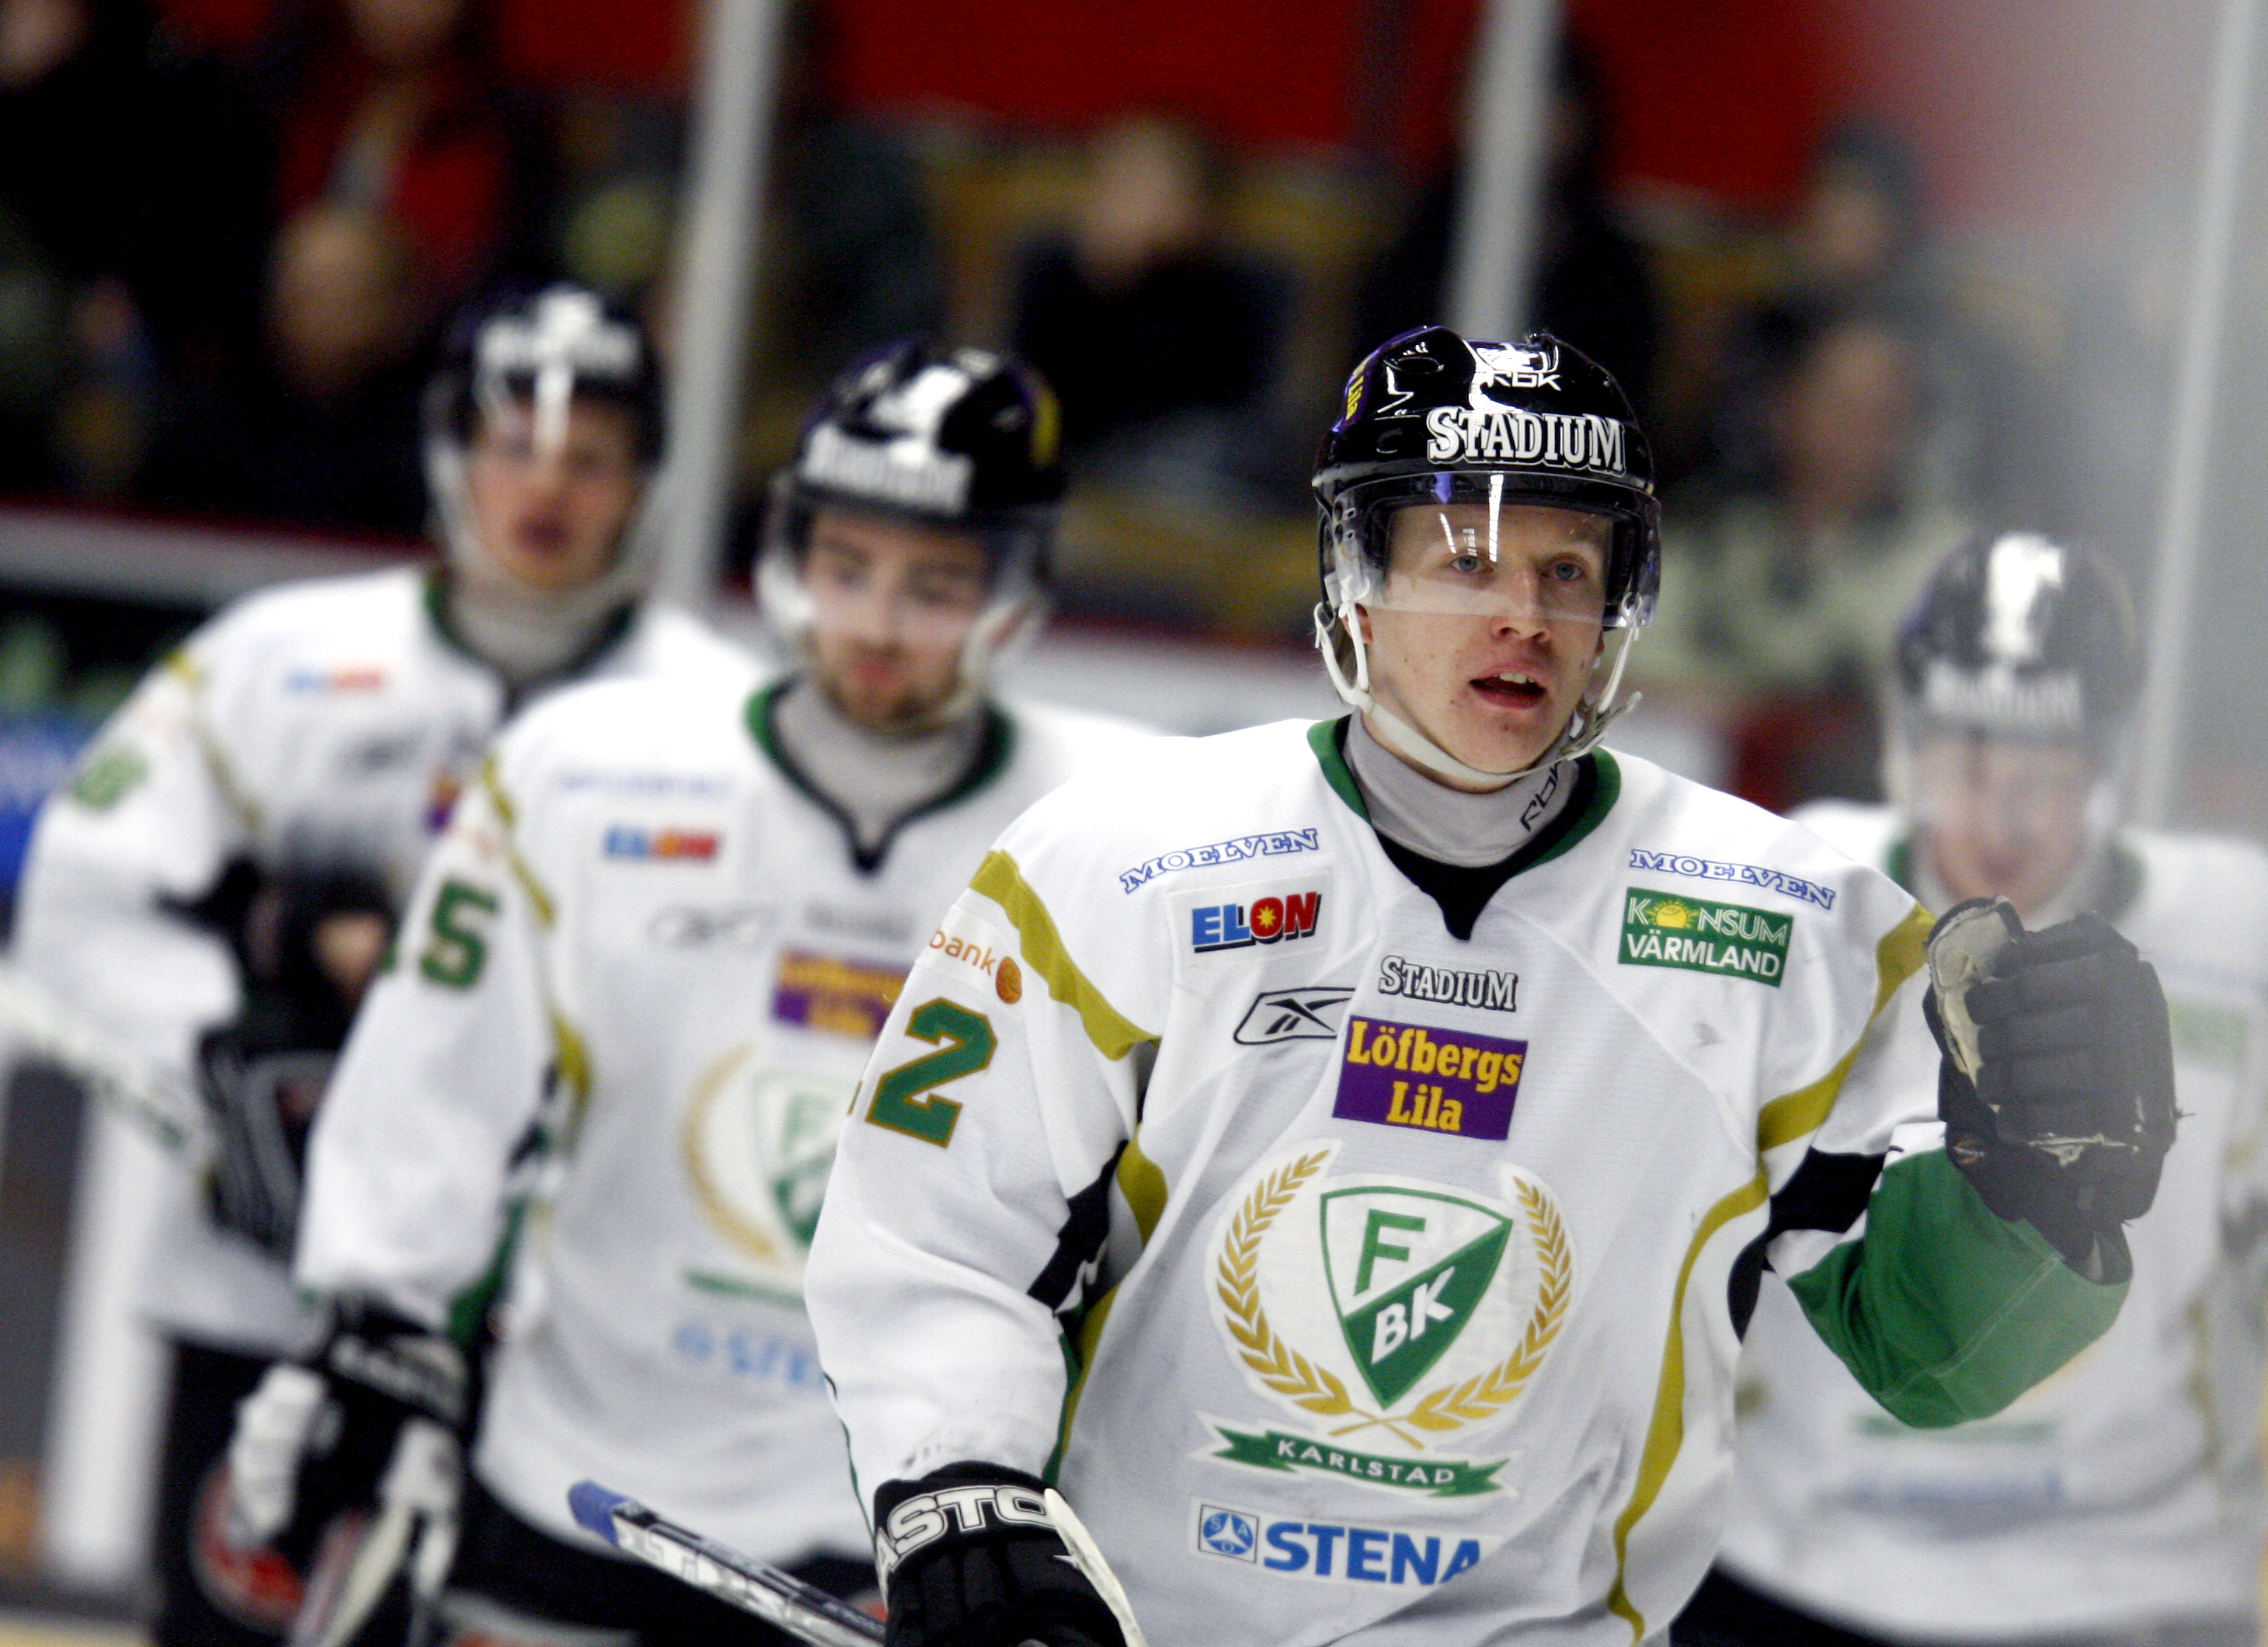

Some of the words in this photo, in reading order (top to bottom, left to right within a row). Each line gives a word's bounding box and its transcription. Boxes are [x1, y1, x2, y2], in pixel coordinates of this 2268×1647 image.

[1427, 406, 1626, 476] STADIUM
[1120, 828, 1319, 894] MOELVEN
[1630, 849, 1836, 911] MOELVEN
[387, 879, 499, 991] 5
[929, 924, 997, 976] bank
[1191, 892, 1322, 953] ELON
[1626, 929, 1779, 977] VÄRMLAND
[1378, 955, 1518, 1012] STADIUM
[847, 997, 998, 1148] 2
[1347, 1020, 1523, 1094] Löfbergs
[1386, 1080, 1463, 1132] Lila
[1354, 1208, 1426, 1297] F
[1372, 1266, 1456, 1365] BK
[1278, 1440, 1455, 1485] KARLSTAD
[1264, 1521, 1480, 1586] STENA
